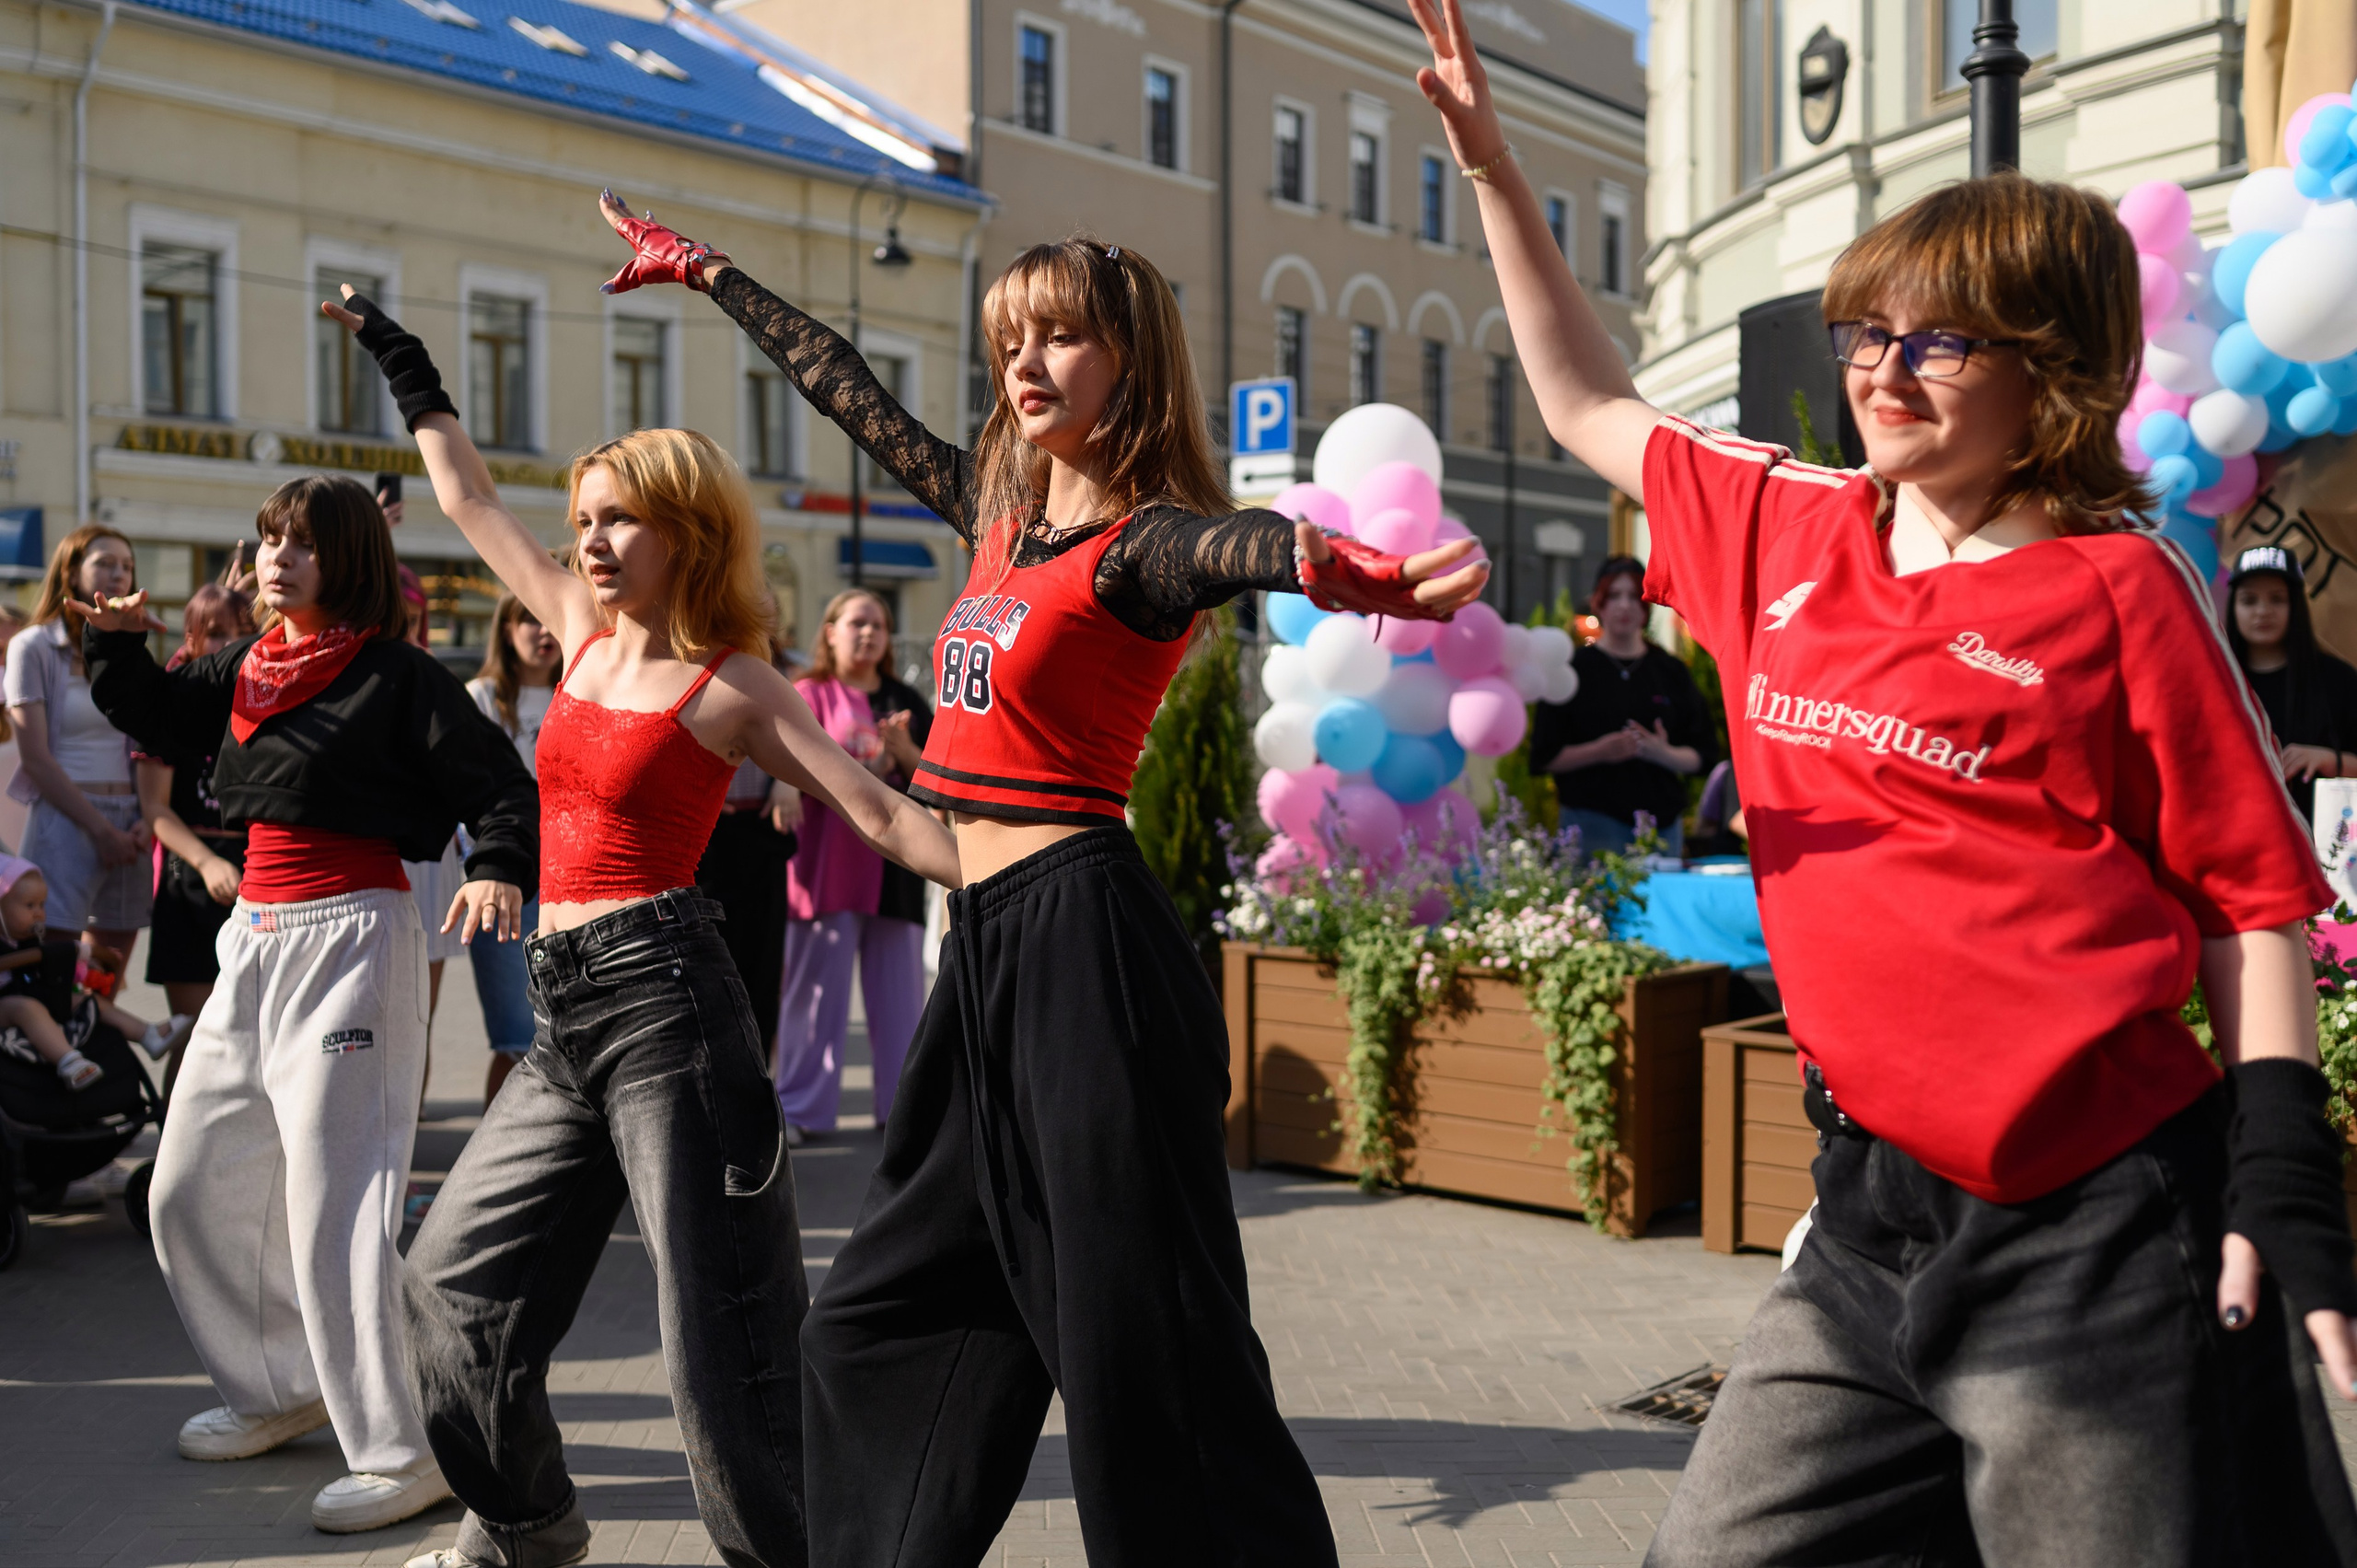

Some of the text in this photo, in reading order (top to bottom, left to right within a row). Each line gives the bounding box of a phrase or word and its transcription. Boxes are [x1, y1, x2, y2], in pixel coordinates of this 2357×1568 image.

[1246, 388, 1286, 450] P
[2240, 546, 2287, 572] KOREA
[937, 595, 1031, 652] BULLS
[939, 636, 994, 715] 88
[322, 1028, 374, 1049] SCULPTOR
